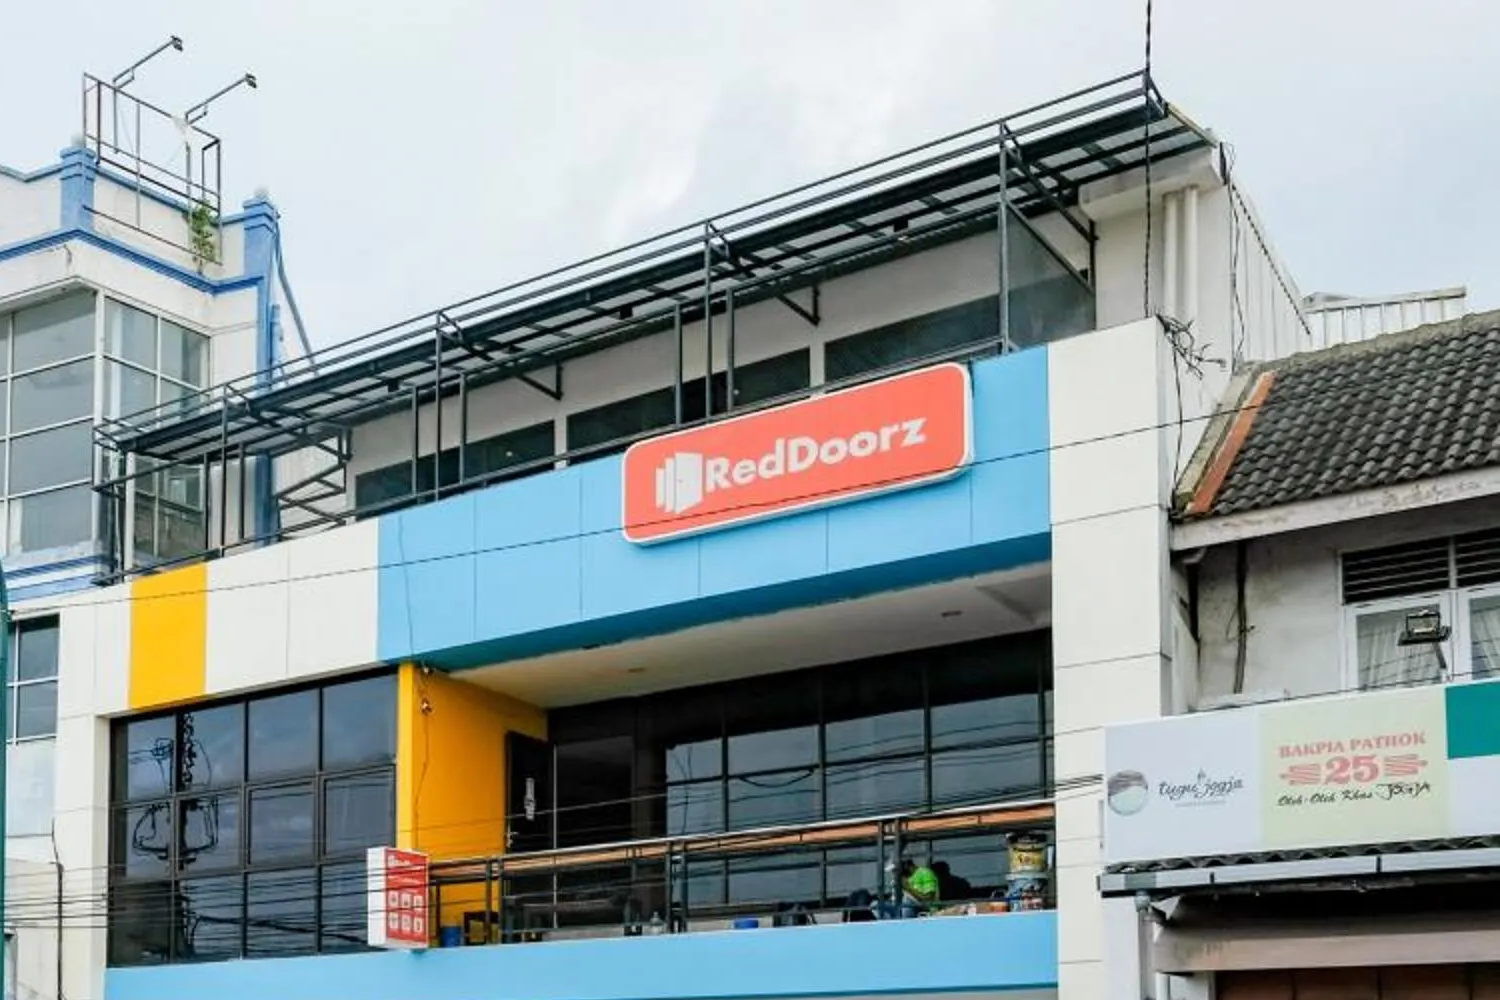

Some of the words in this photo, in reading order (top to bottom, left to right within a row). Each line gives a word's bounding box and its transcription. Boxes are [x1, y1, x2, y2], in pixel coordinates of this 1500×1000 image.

[705, 417, 928, 493] RedDoorz
[1279, 740, 1345, 758] BAKPIA
[1350, 731, 1427, 751] PATHOK
[1324, 754, 1379, 786] 25
